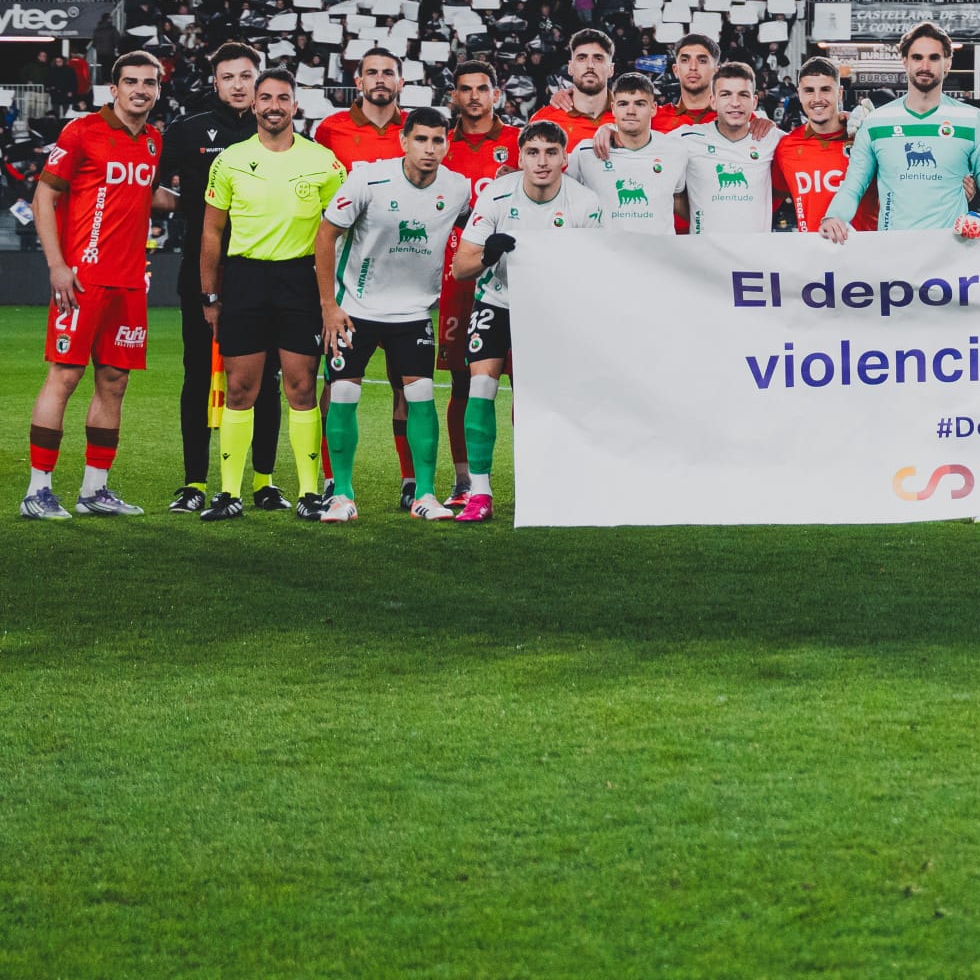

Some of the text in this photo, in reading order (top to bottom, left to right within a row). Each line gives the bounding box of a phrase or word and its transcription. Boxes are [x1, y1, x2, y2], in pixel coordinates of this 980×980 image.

[939, 10, 955, 21] DE
[794, 169, 844, 195] DIG
[900, 172, 943, 181] plenitude
[711, 193, 754, 203] plenitude
[611, 210, 654, 219] plenitude
[388, 245, 432, 256] plenitude
[731, 269, 782, 308] El
